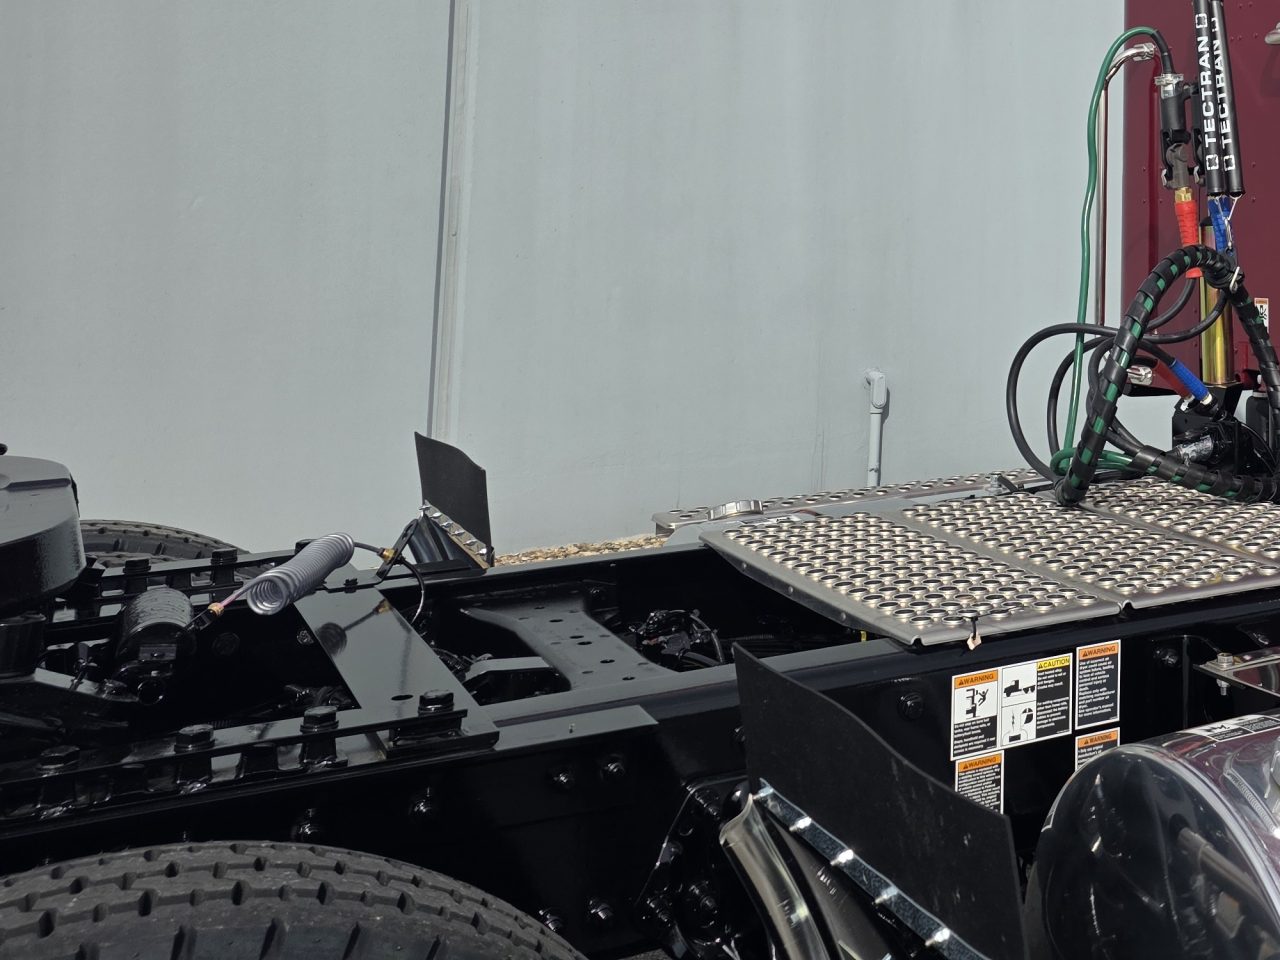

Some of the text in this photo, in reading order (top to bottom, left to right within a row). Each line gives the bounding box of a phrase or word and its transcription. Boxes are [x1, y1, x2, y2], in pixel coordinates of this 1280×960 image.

[1197, 35, 1219, 149] TECTRAN
[1087, 645, 1116, 656] WARNING
[1043, 657, 1070, 668] CAUTION
[963, 673, 994, 685] WARNING
[968, 757, 997, 768] WARNING
